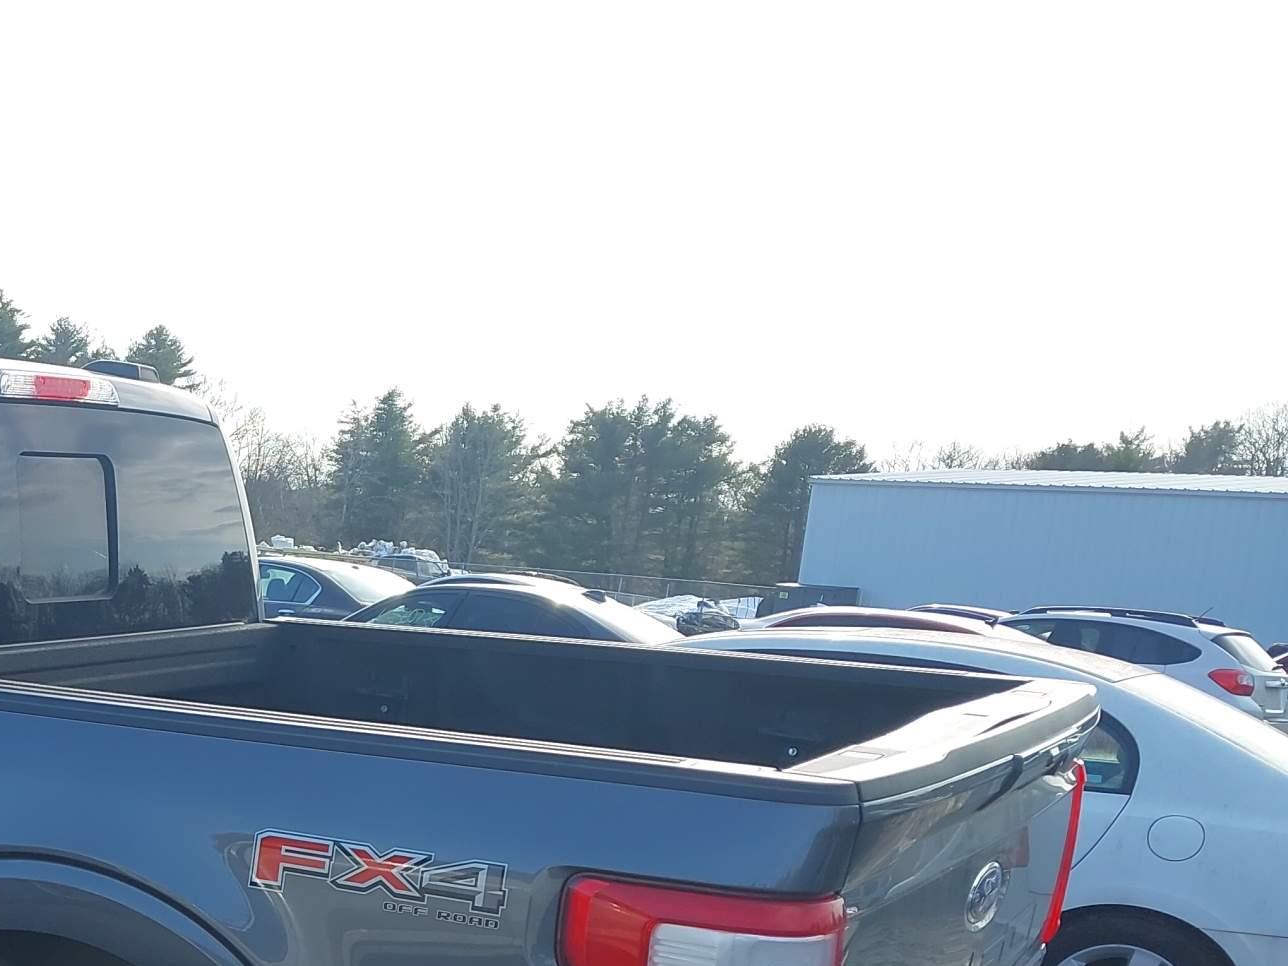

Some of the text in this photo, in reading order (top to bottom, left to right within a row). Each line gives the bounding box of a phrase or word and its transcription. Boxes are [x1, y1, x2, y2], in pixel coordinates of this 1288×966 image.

[248, 829, 508, 917] FX4
[383, 901, 500, 930] OFF ROAD
